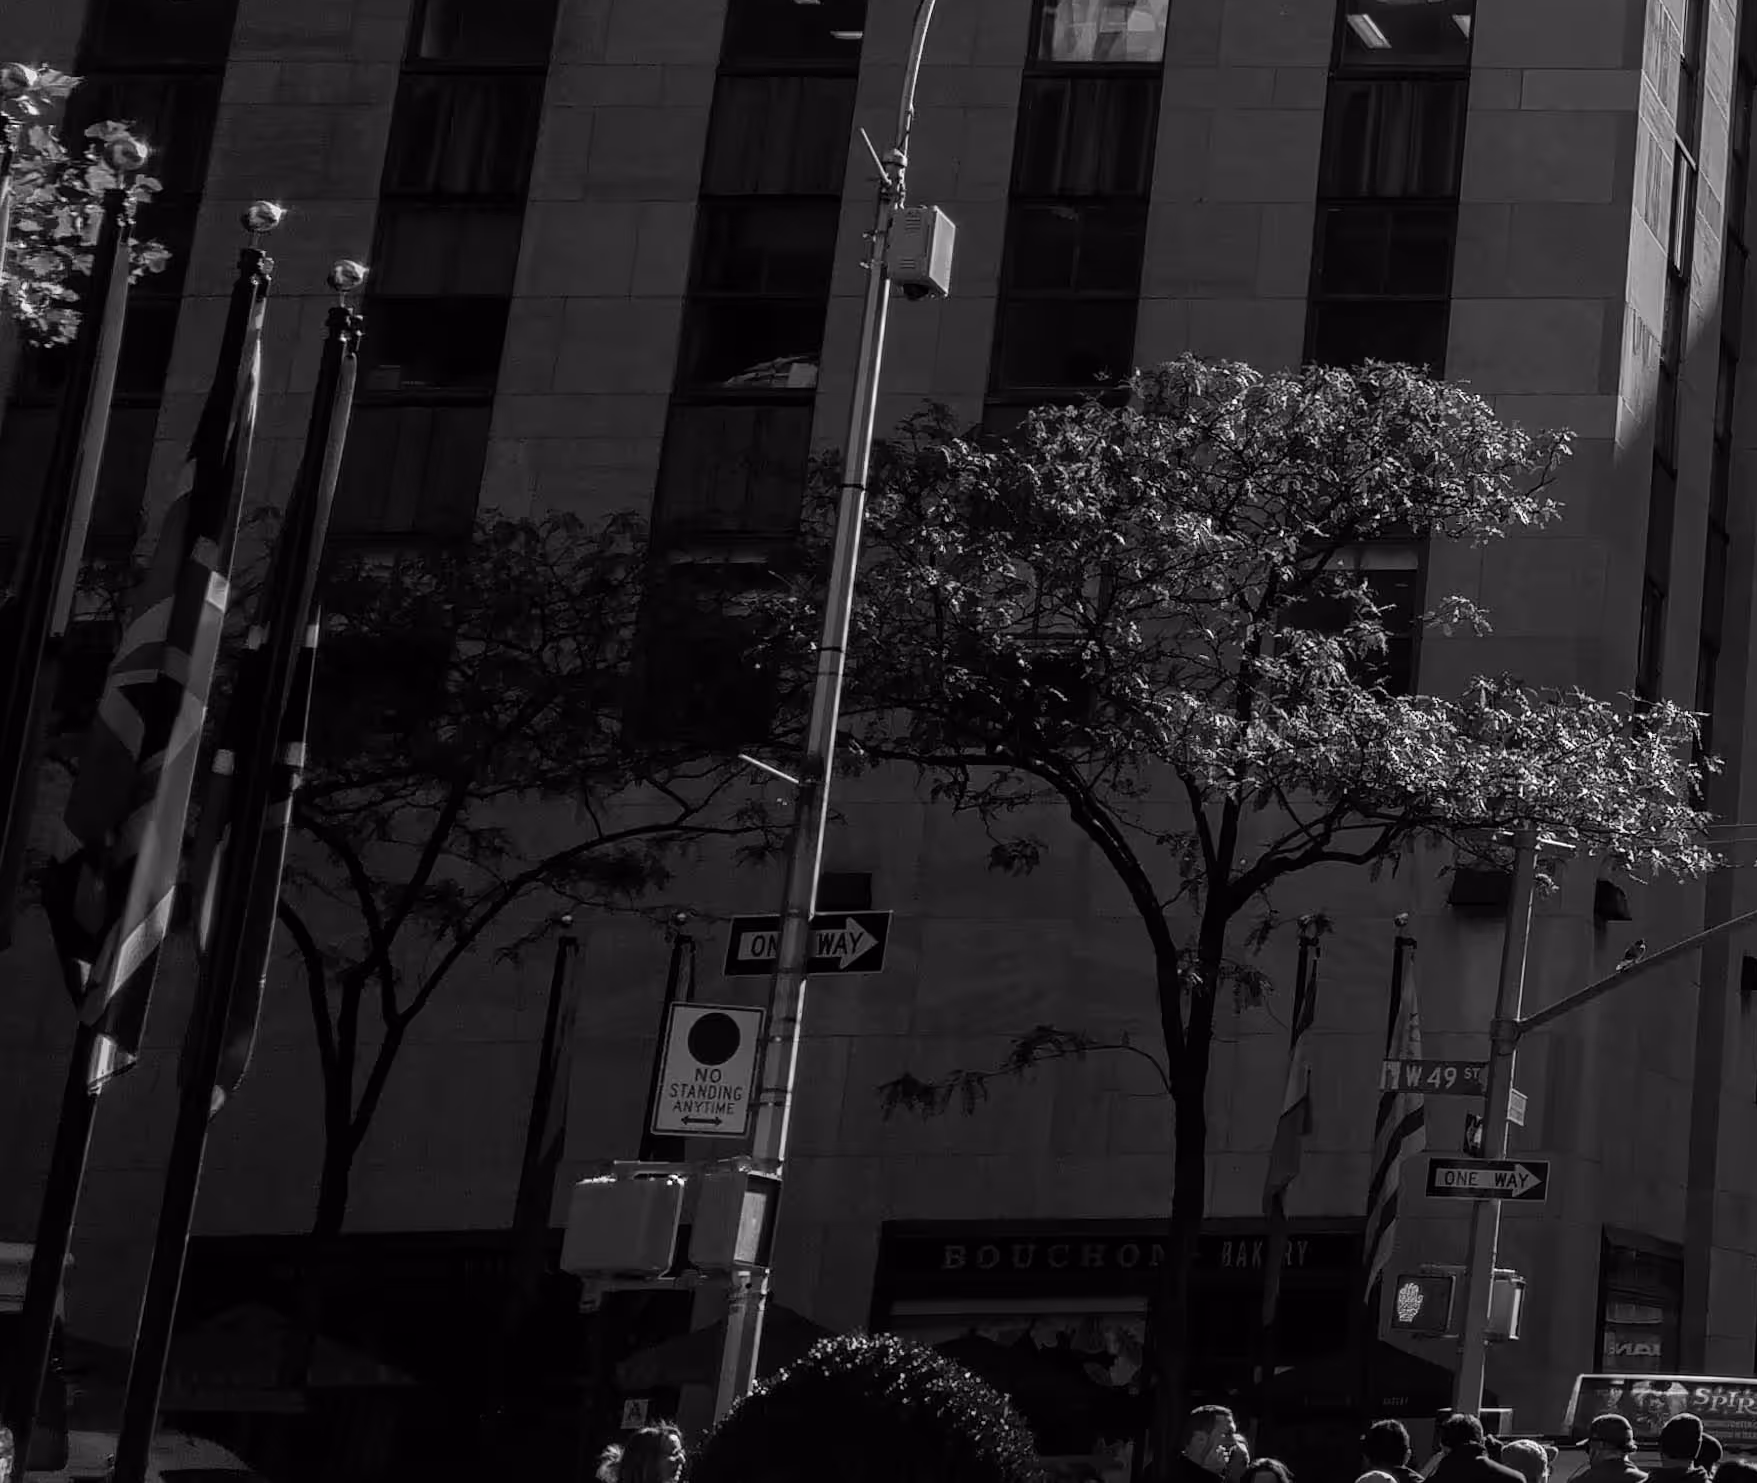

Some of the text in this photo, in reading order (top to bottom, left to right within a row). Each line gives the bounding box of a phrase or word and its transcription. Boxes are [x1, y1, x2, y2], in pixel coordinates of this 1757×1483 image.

[817, 931, 863, 955] WAY
[694, 1068, 722, 1083] NO
[1405, 1064, 1481, 1090] W 49 ST
[669, 1083, 743, 1101] STANDING
[672, 1102, 735, 1115] ANYTIME
[1444, 1170, 1529, 1188] ONE WAY
